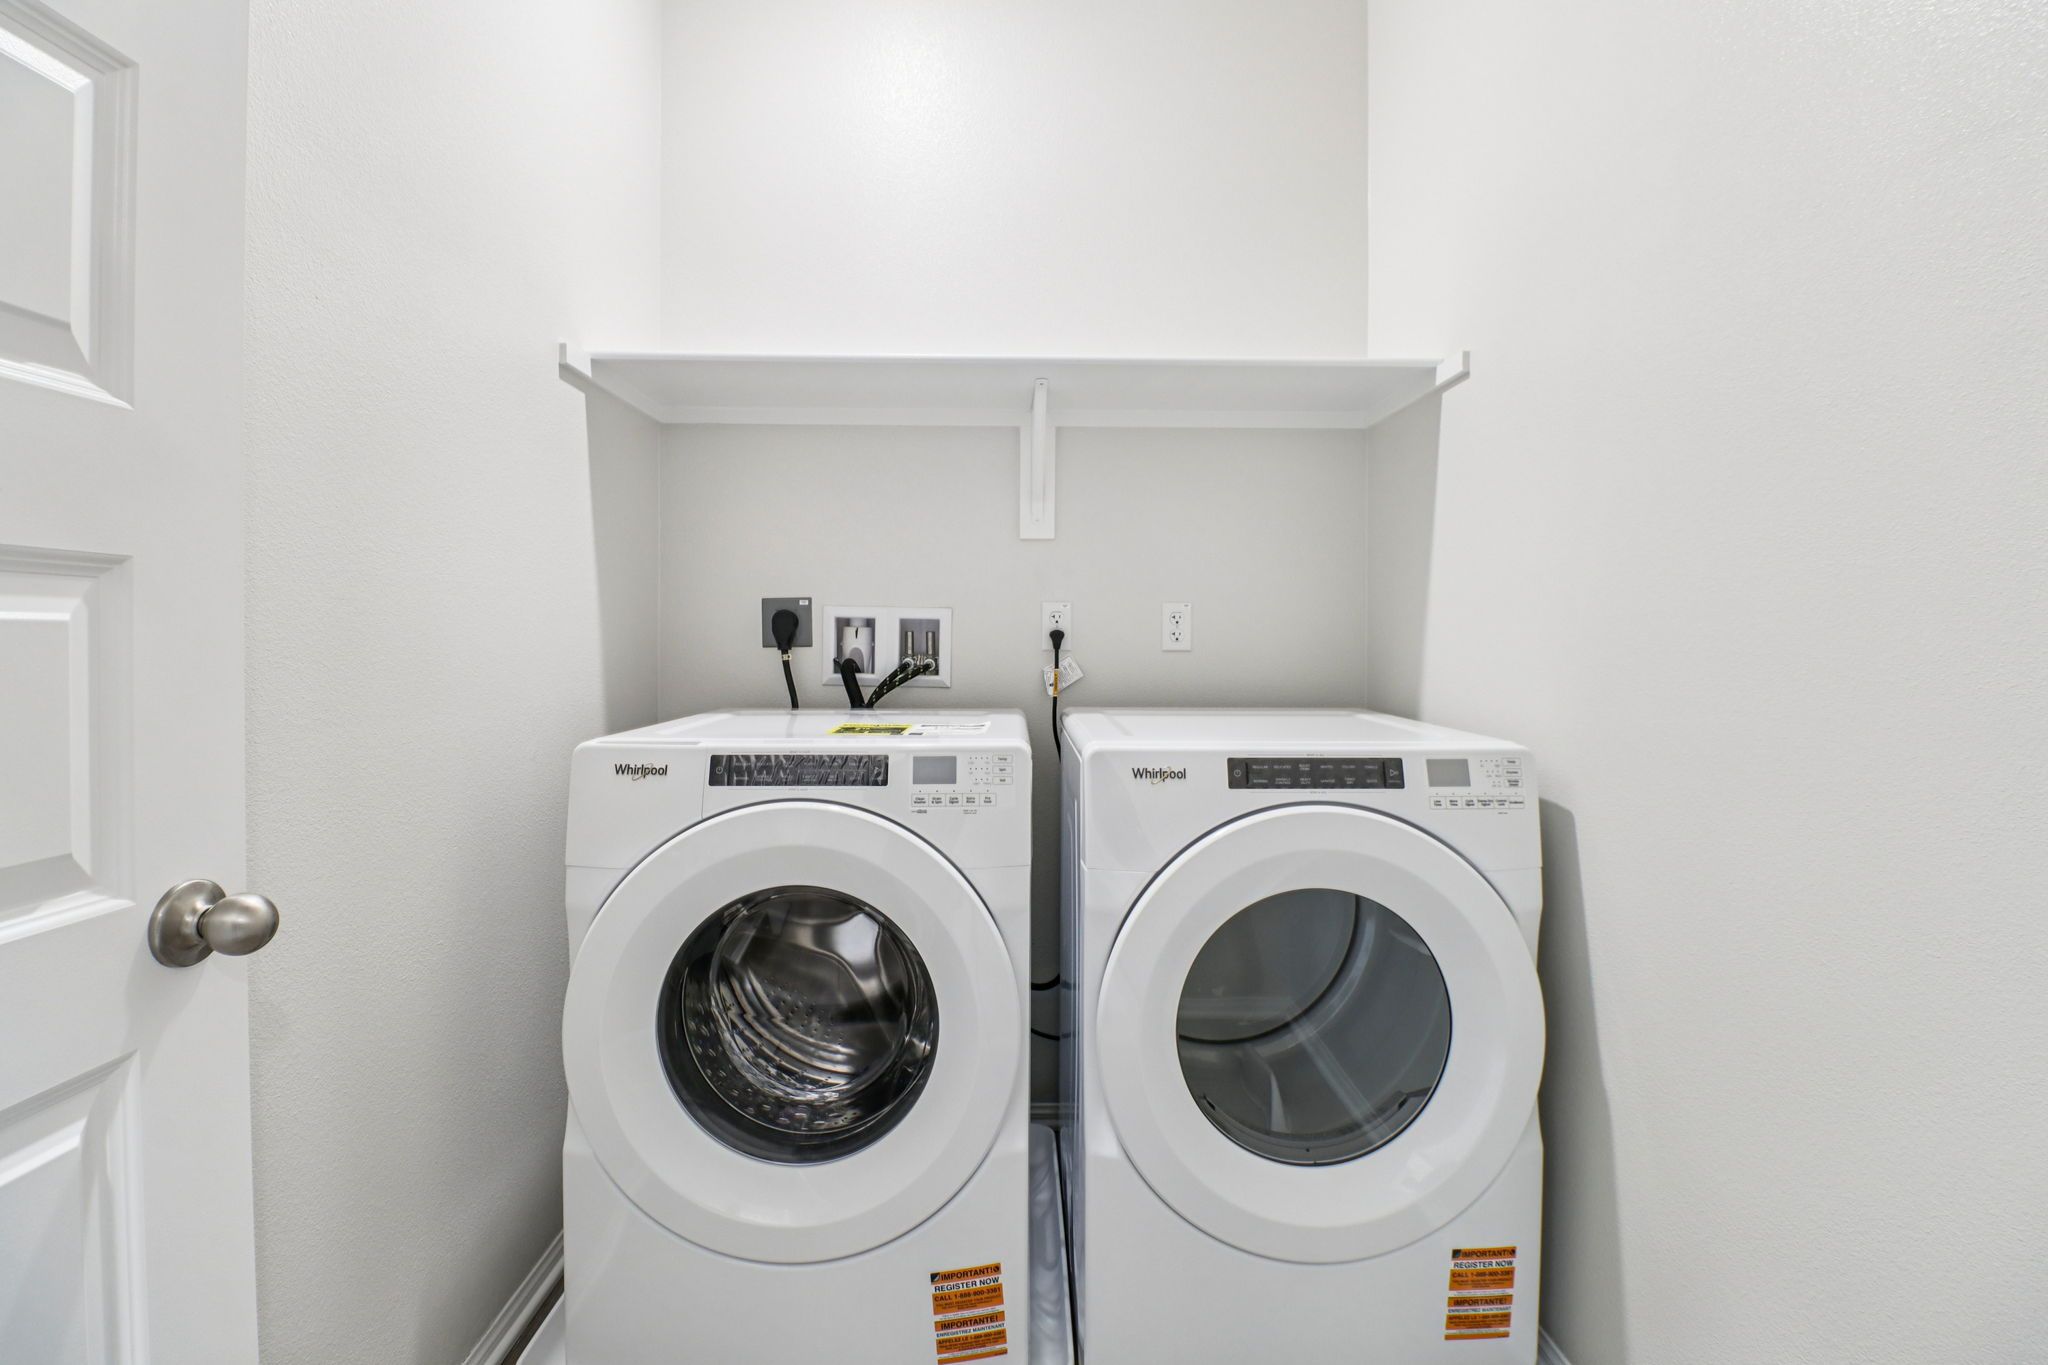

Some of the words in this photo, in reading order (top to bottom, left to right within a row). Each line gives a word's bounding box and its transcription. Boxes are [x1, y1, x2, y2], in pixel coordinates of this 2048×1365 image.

[614, 763, 668, 779] Whirlpool
[1131, 767, 1187, 782] Whirlpool
[1453, 1261, 1494, 1269] REGISTER
[941, 1266, 993, 1281] IMPORTANT!
[934, 1280, 978, 1293] REGISTER
[979, 1276, 1000, 1286] NOW
[934, 1293, 952, 1302] CALL
[940, 1315, 998, 1331] IMPORTANTE!
